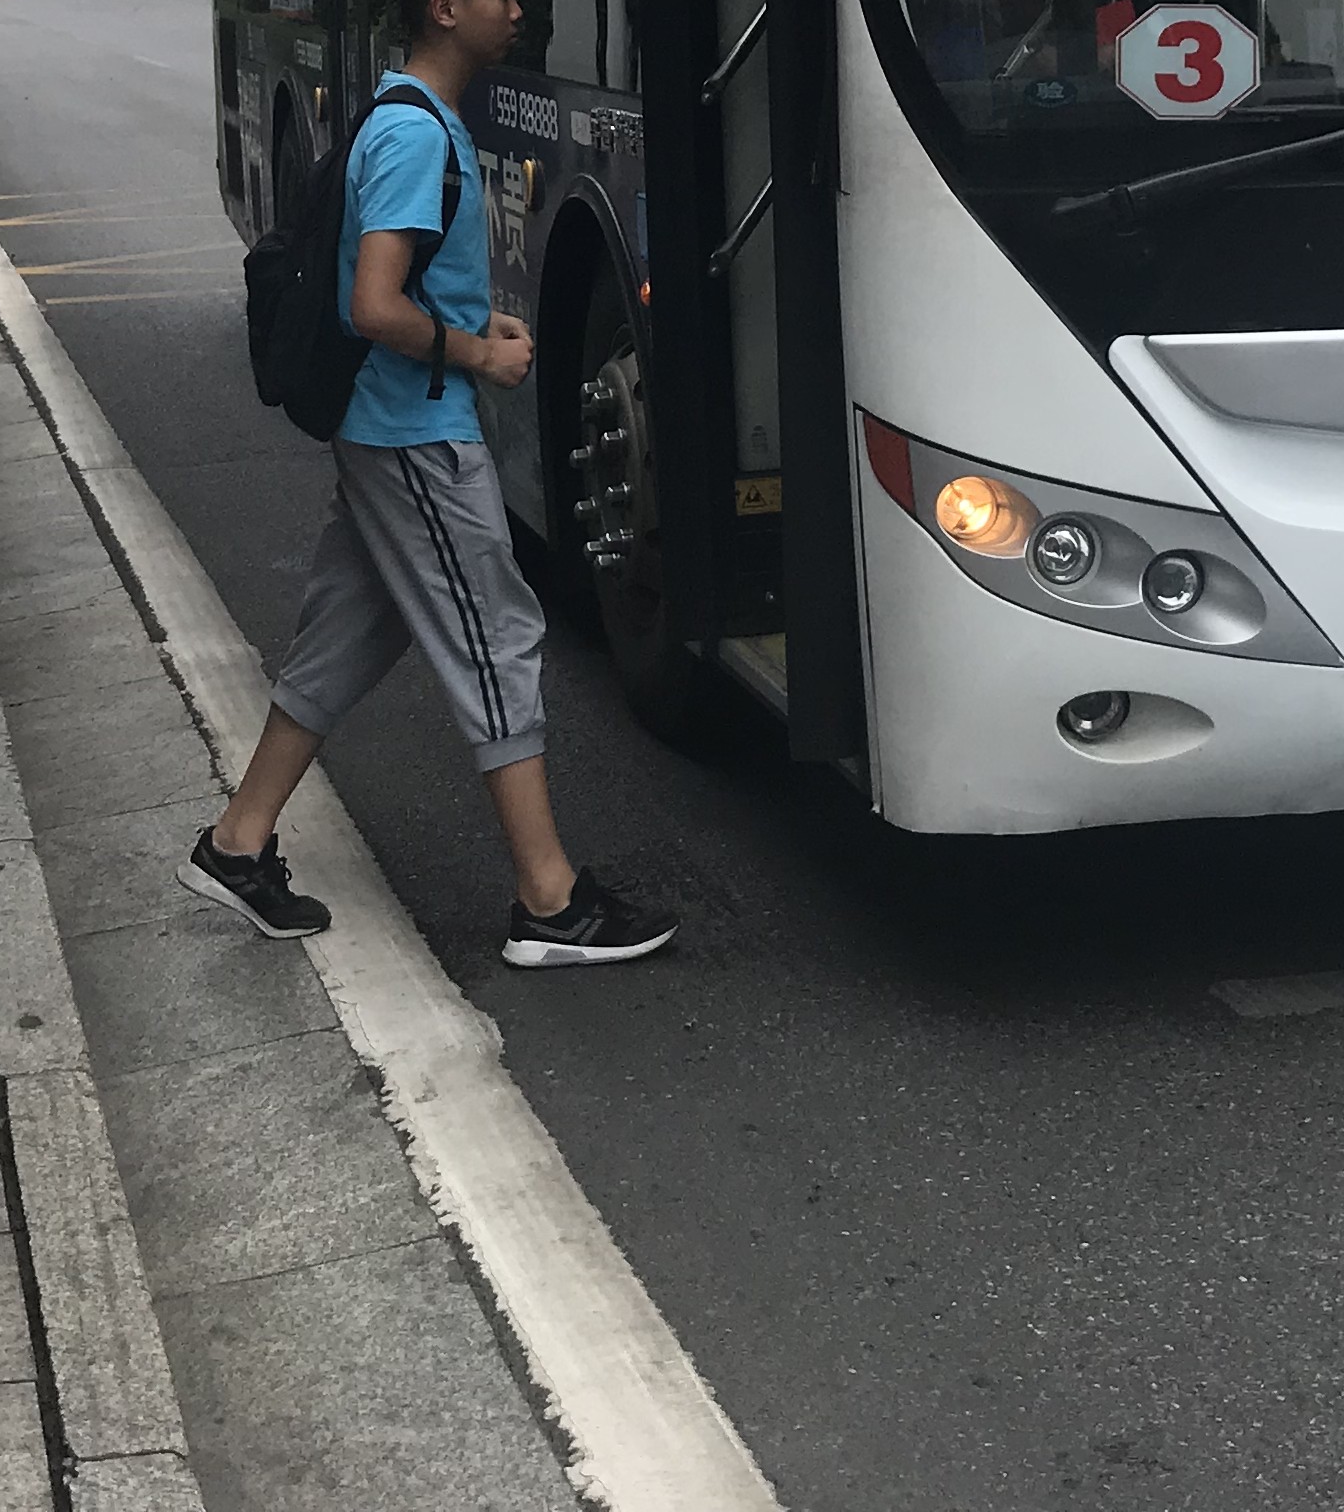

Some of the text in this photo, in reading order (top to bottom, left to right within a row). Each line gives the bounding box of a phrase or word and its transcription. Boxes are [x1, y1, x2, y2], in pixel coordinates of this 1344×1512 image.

[1154, 20, 1225, 103] 3
[497, 85, 517, 128] 559
[519, 91, 558, 141] 88888
